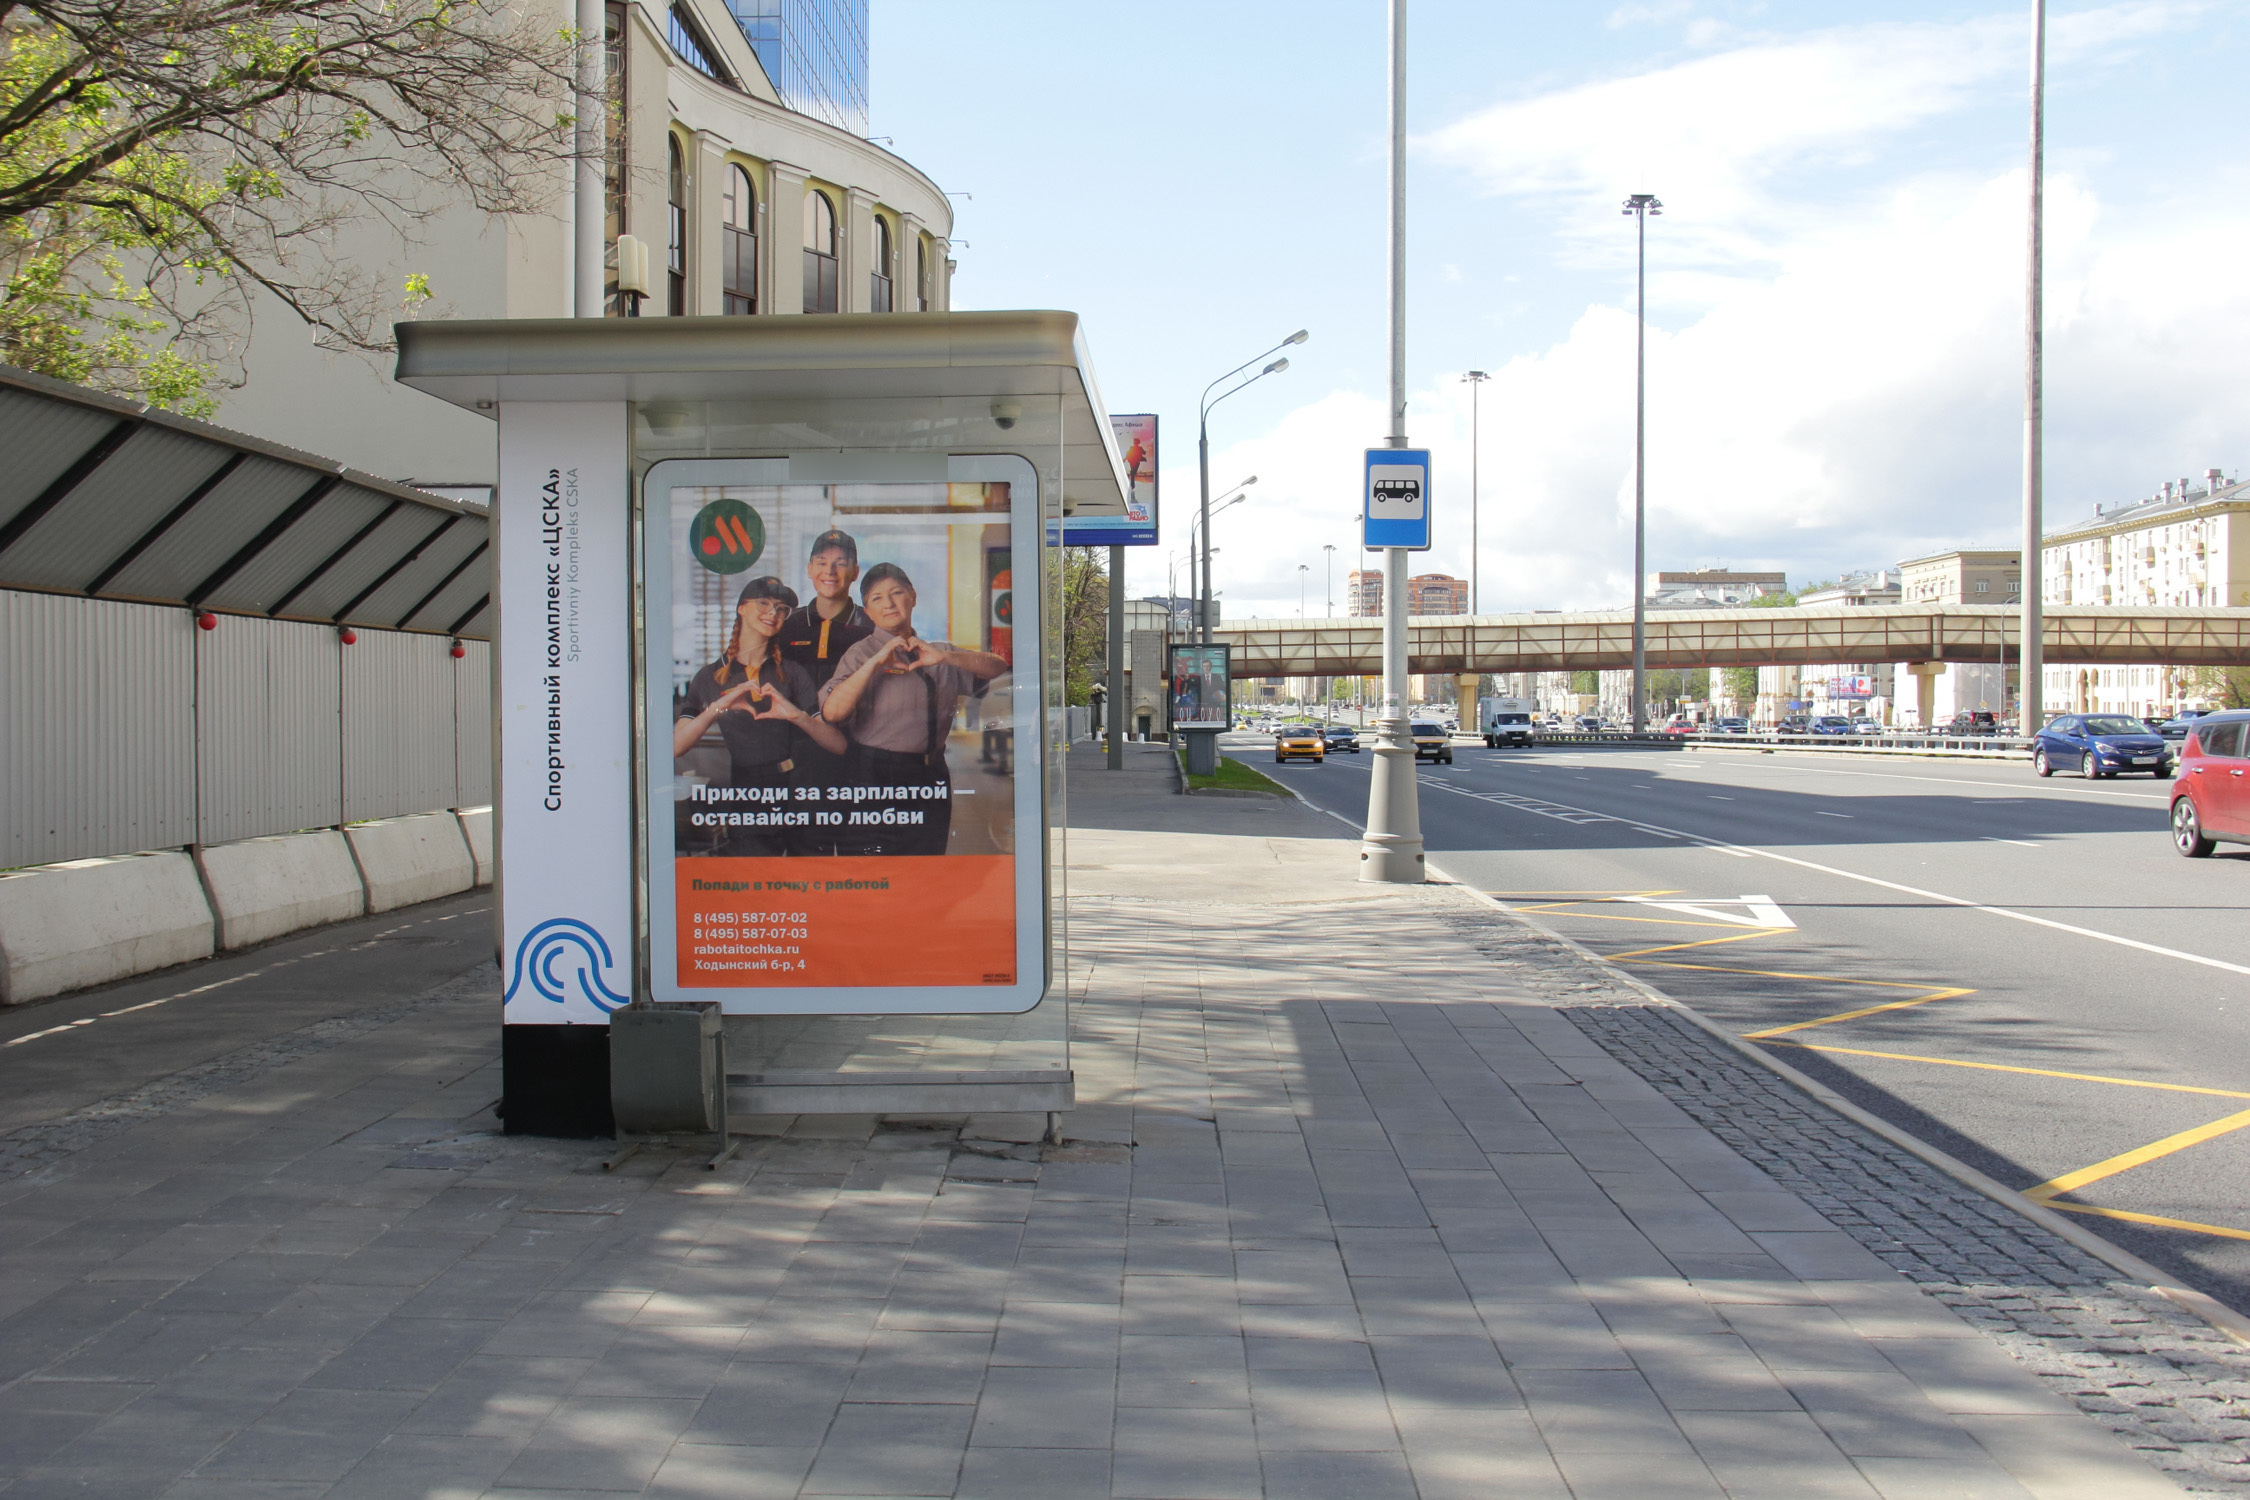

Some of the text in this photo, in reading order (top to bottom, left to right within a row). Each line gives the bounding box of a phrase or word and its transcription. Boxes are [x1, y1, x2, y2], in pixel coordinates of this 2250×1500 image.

[566, 467, 582, 662] Sportivniy Kompleks CSKA
[543, 468, 564, 812] Спортивный комплекс «ЦСКА»
[691, 784, 789, 805] Приходи
[794, 788, 821, 801] за
[826, 780, 948, 804] зарплатой
[691, 807, 924, 826] оставайся по любви
[692, 877, 890, 893] Попади в точку с работой
[693, 912, 808, 925] 8 (495) 587-07-02
[693, 927, 808, 941] 8 (495) 587-07-03
[694, 944, 800, 955] rabotaitochka.ru
[694, 959, 806, 972] Ходынский б-р, 4
